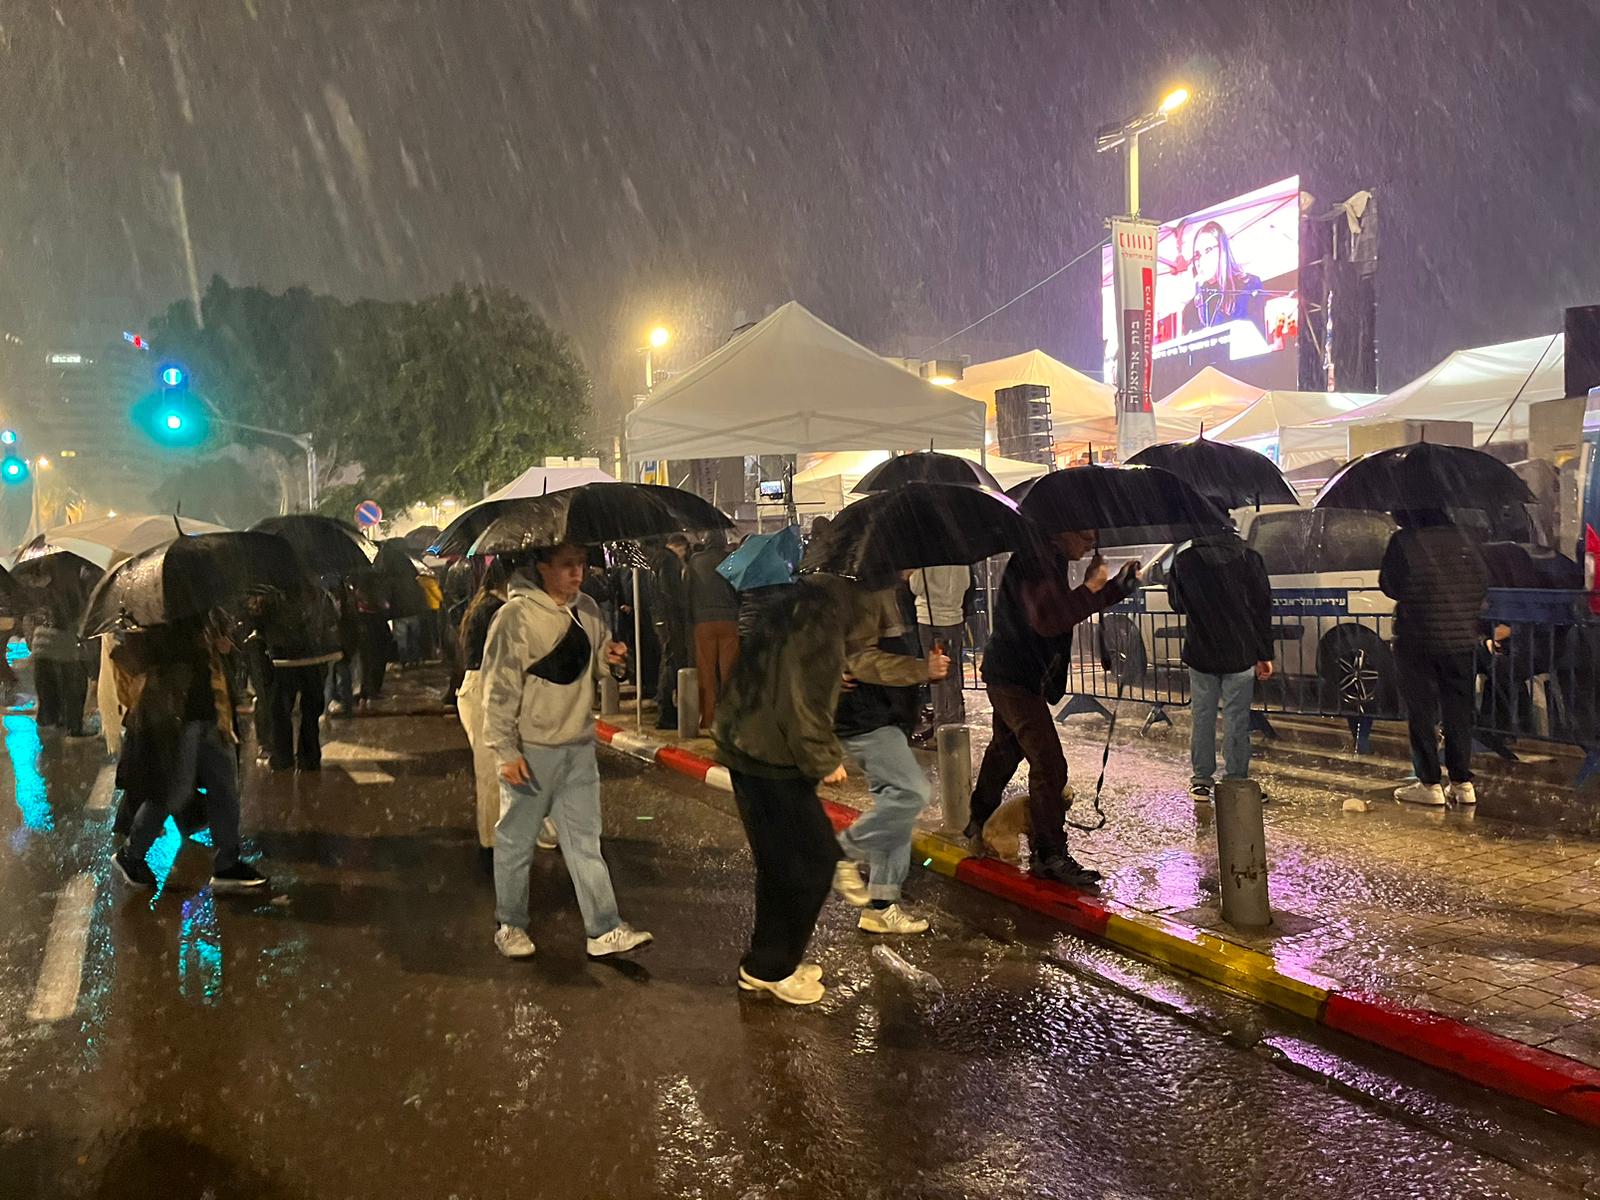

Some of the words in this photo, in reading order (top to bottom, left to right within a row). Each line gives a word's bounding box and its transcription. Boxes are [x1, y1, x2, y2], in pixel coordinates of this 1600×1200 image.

[1131, 320, 1140, 345] בית
[1128, 351, 1140, 404] אריאלה
[1315, 598, 1346, 606] עיריית
